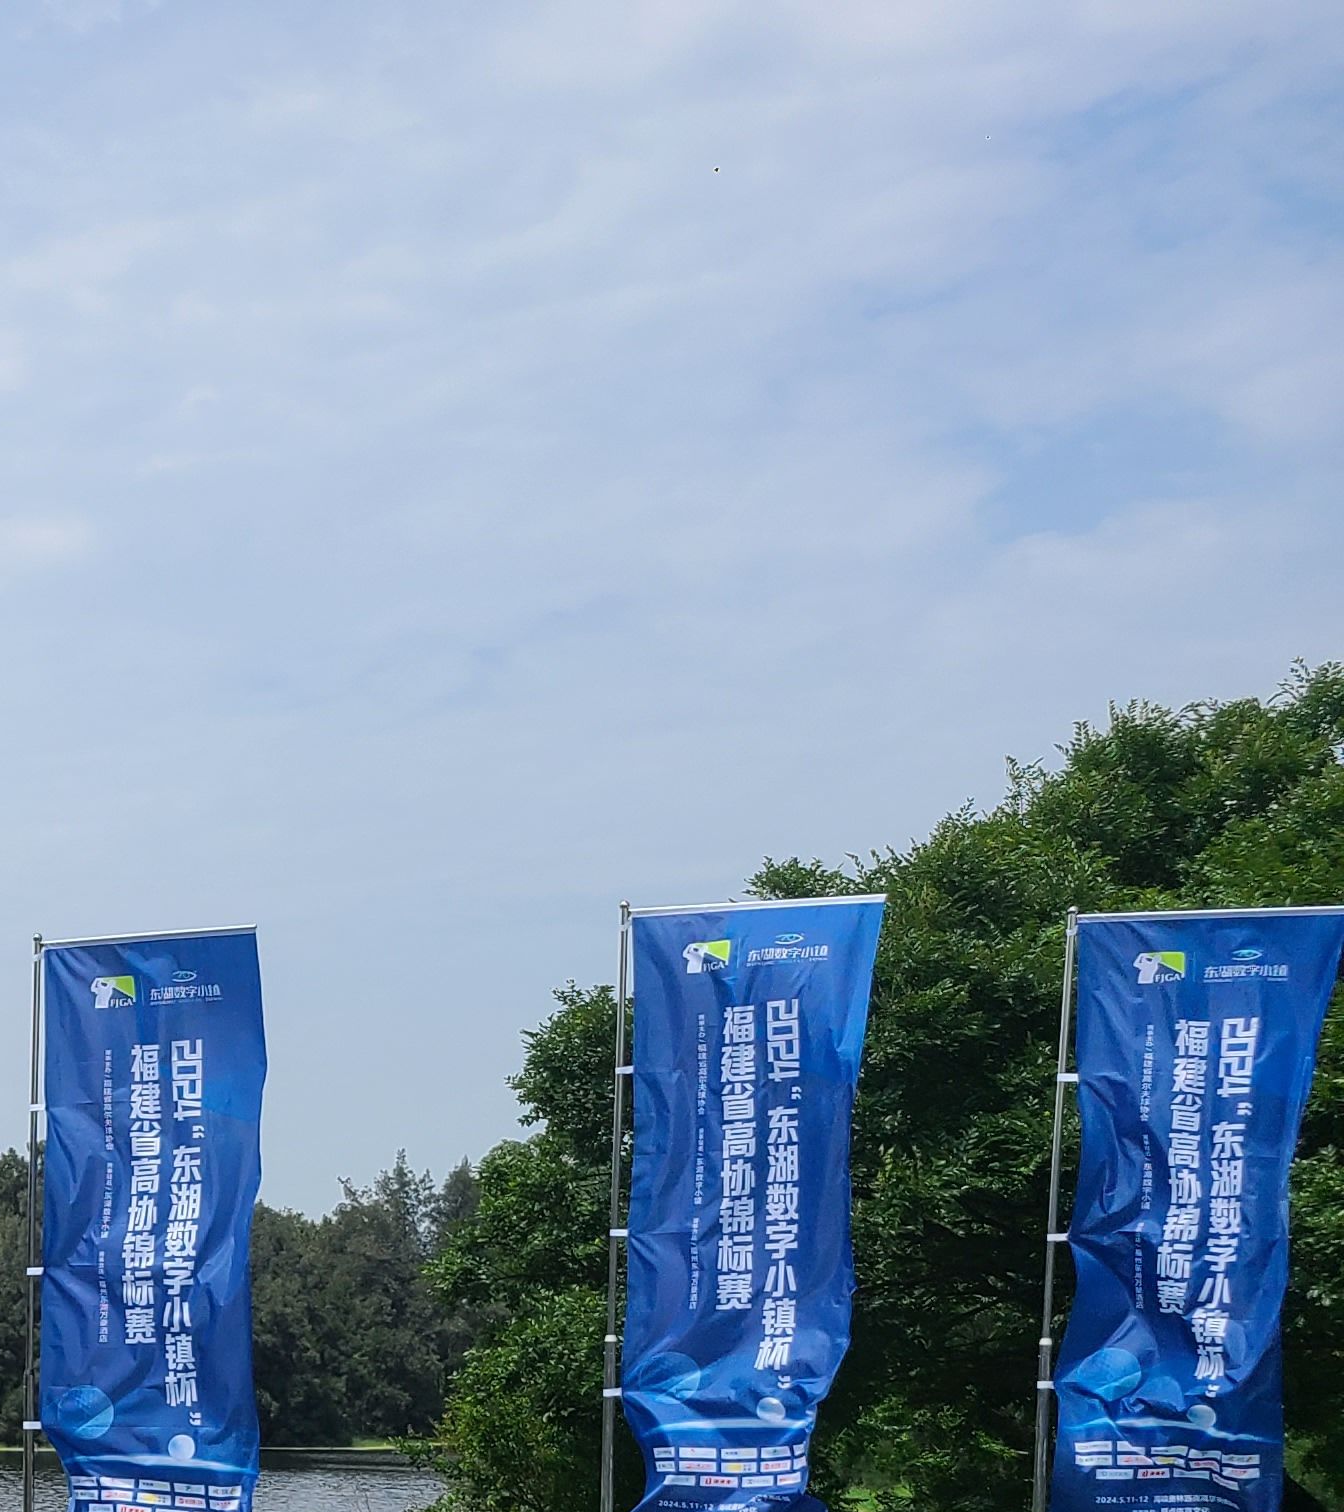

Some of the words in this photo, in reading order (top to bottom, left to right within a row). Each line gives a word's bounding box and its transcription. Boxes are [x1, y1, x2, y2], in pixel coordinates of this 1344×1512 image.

[1154, 973, 1181, 983] FJGA
[122, 1044, 161, 1344] 福建省高协锦标赛
[716, 1005, 756, 1311] 福建省高协锦标赛
[1157, 1019, 1210, 1315] 福建省高协锦标赛
